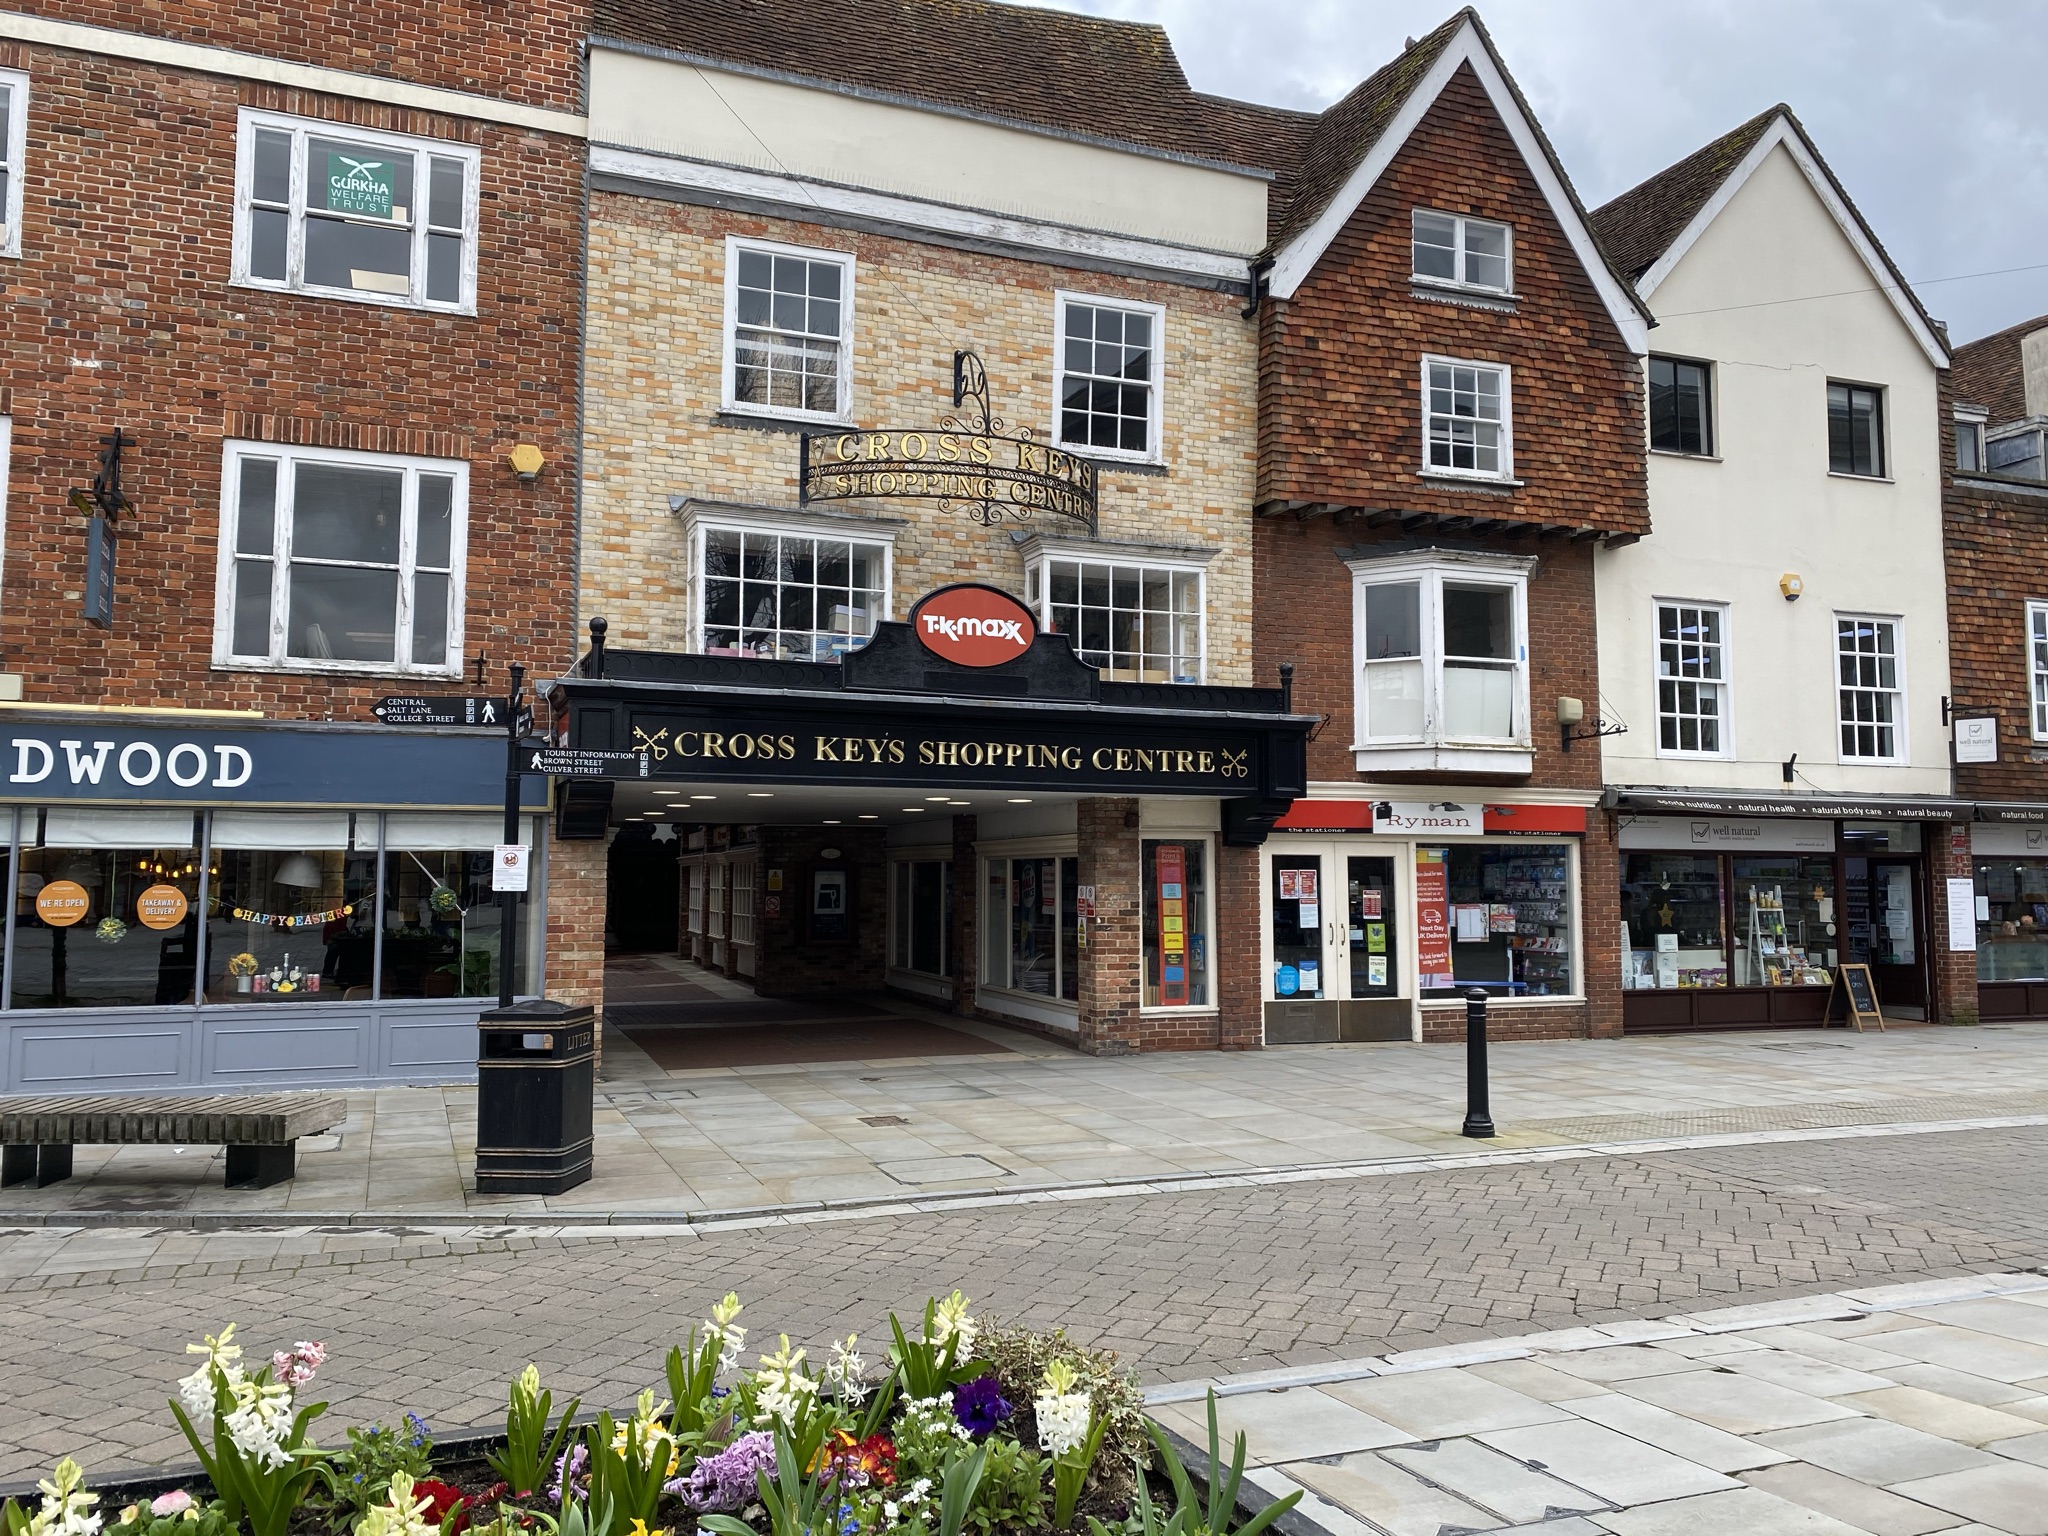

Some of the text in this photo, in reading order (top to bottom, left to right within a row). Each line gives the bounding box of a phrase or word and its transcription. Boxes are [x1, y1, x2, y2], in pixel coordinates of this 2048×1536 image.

[331, 176, 389, 195] GURKHA
[331, 188, 389, 205] WELFARE
[331, 197, 389, 213] TRUST
[836, 432, 1092, 490] CROSS KEYS
[835, 472, 1092, 521] SHOPPING CENTRE
[544, 750, 635, 759] TOURIST INFORMATION
[674, 731, 796, 760] CROSS
[918, 740, 1083, 770] SHOPPING
[1092, 747, 1215, 774] CENTRE
[9, 738, 253, 788] DWOOD
[543, 765, 572, 773] CULVER
[574, 766, 604, 774] STREET
[1686, 801, 1722, 810] nutrition
[1738, 804, 1768, 812] natural
[1769, 804, 1796, 813] health
[1812, 806, 1841, 815] natural
[1842, 807, 1864, 816] body
[1865, 808, 1882, 816] care
[1897, 809, 1925, 817] natural
[1926, 809, 1953, 818] beauty
[2001, 811, 2044, 820] natural food
[1386, 814, 1472, 829] Ryman
[1712, 826, 1761, 837] well natural
[40, 899, 84, 908] WE'RE OPEN
[142, 899, 181, 907] TAKEAWAY &
[145, 907, 176, 915] DELIVERY
[242, 908, 345, 926] HAPPY EASTER
[567, 1031, 591, 1050] LITTER
